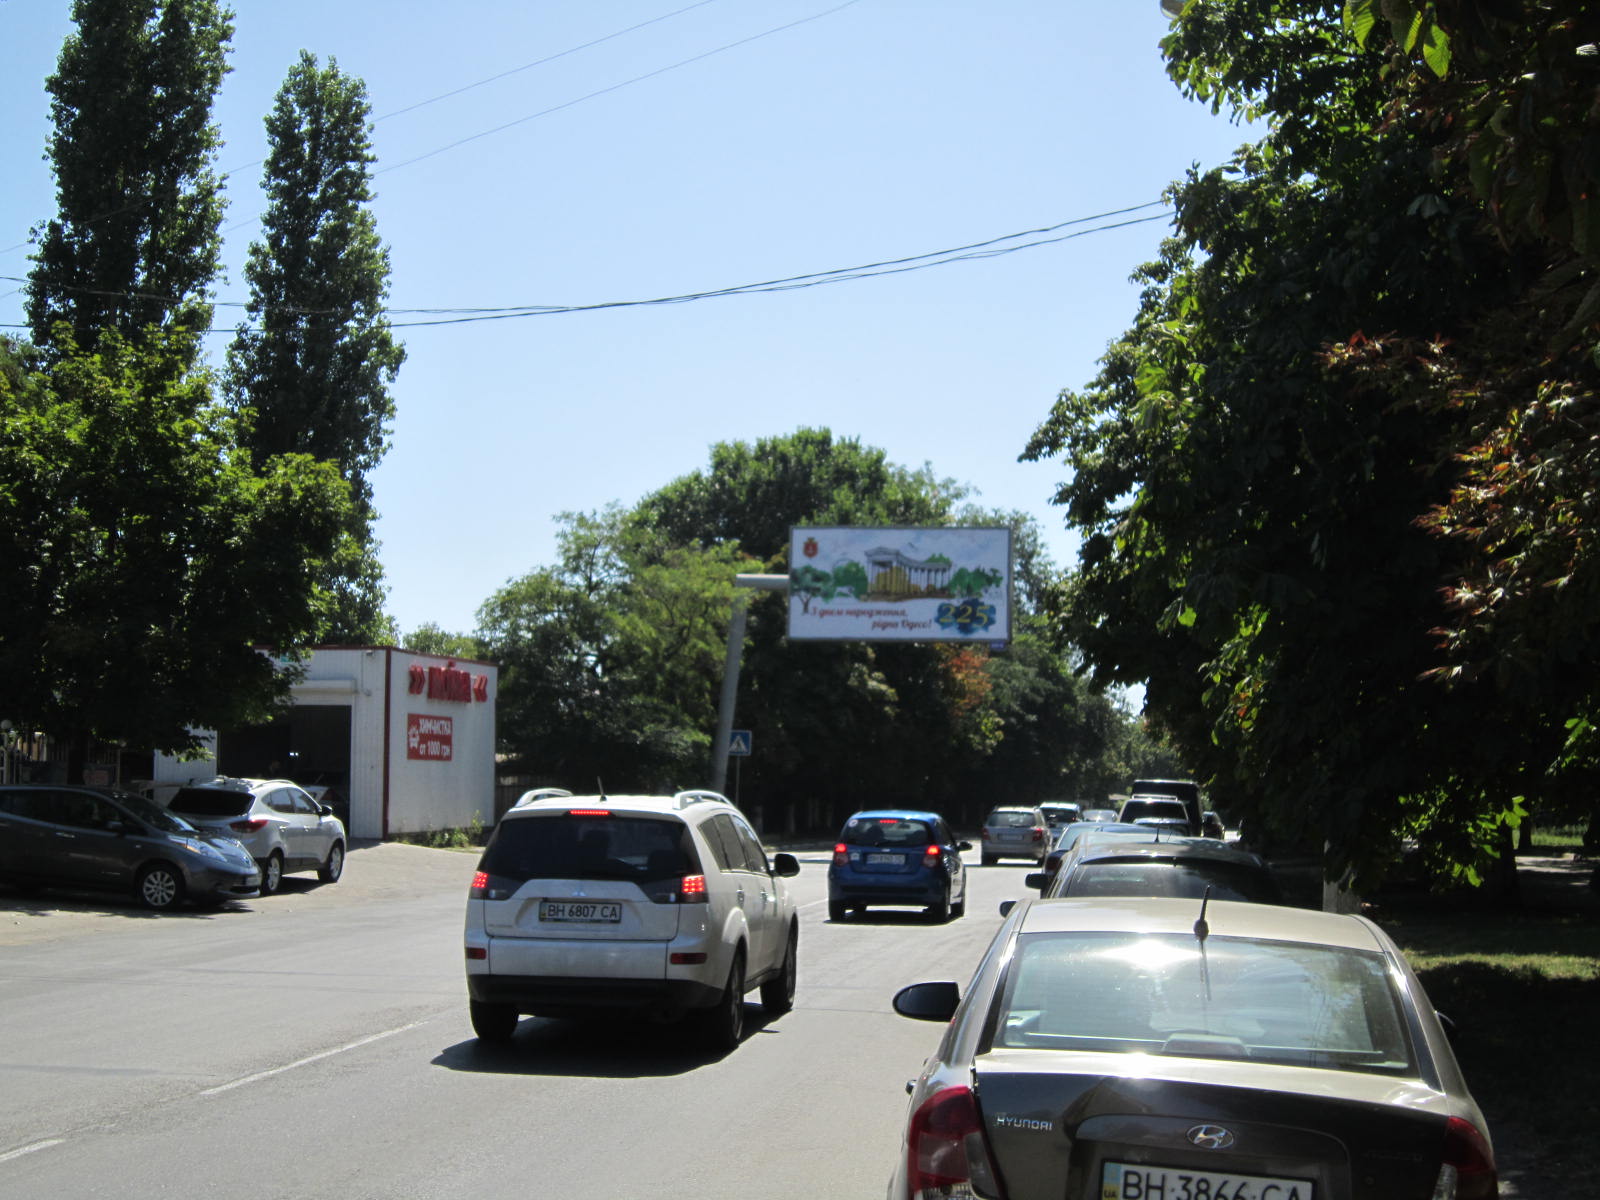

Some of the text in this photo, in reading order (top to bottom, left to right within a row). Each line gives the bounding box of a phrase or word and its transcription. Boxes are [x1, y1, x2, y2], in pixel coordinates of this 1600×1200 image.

[939, 605, 990, 628] 225
[419, 718, 451, 735] ХИМЧИСТКА
[428, 740, 441, 756] 1000
[547, 904, 618, 919] BH 6807 CA
[996, 1115, 1053, 1131] HYUNDAI
[1122, 1170, 1166, 1200] BH
[1177, 1175, 1250, 1200] 3866
